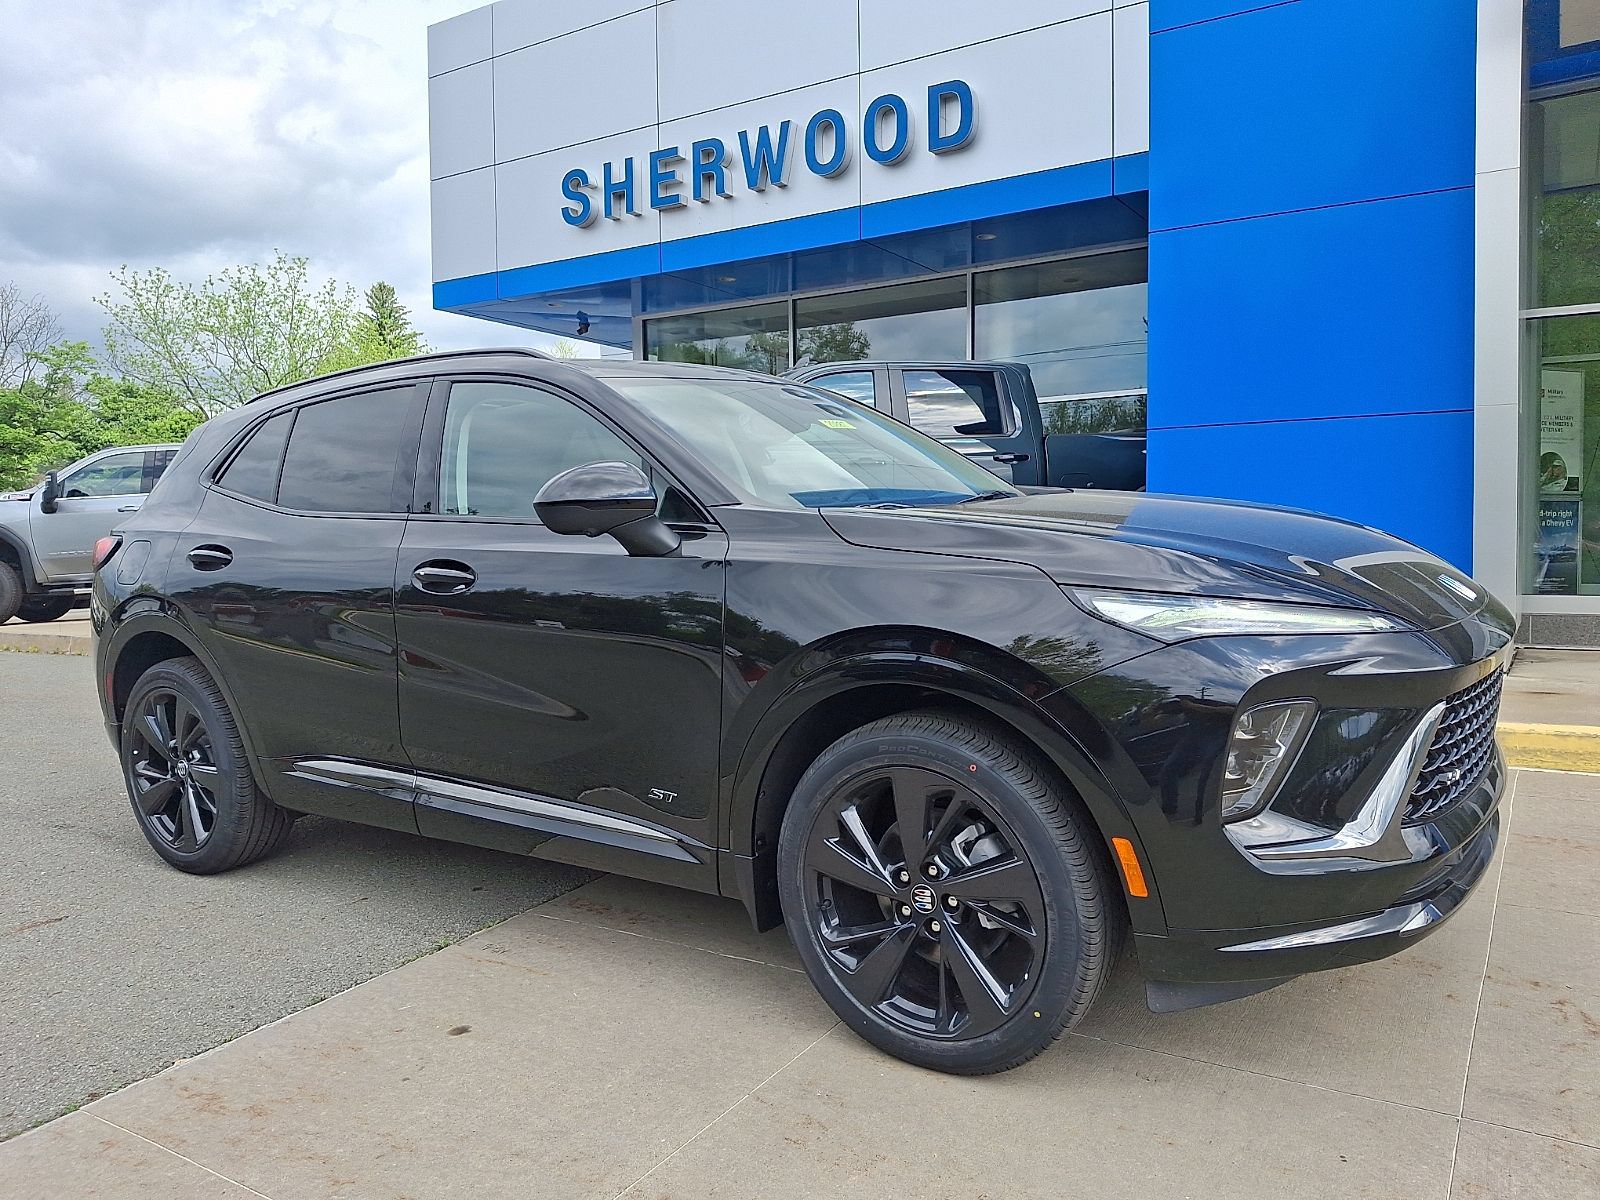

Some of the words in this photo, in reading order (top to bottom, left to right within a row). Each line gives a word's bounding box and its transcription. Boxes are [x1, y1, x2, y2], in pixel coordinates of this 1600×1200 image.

[561, 79, 978, 228] SHERWOOD
[1557, 509, 1573, 518] right
[1546, 519, 1565, 528] Chevy
[1566, 519, 1574, 527] EV
[648, 787, 678, 803] ST
